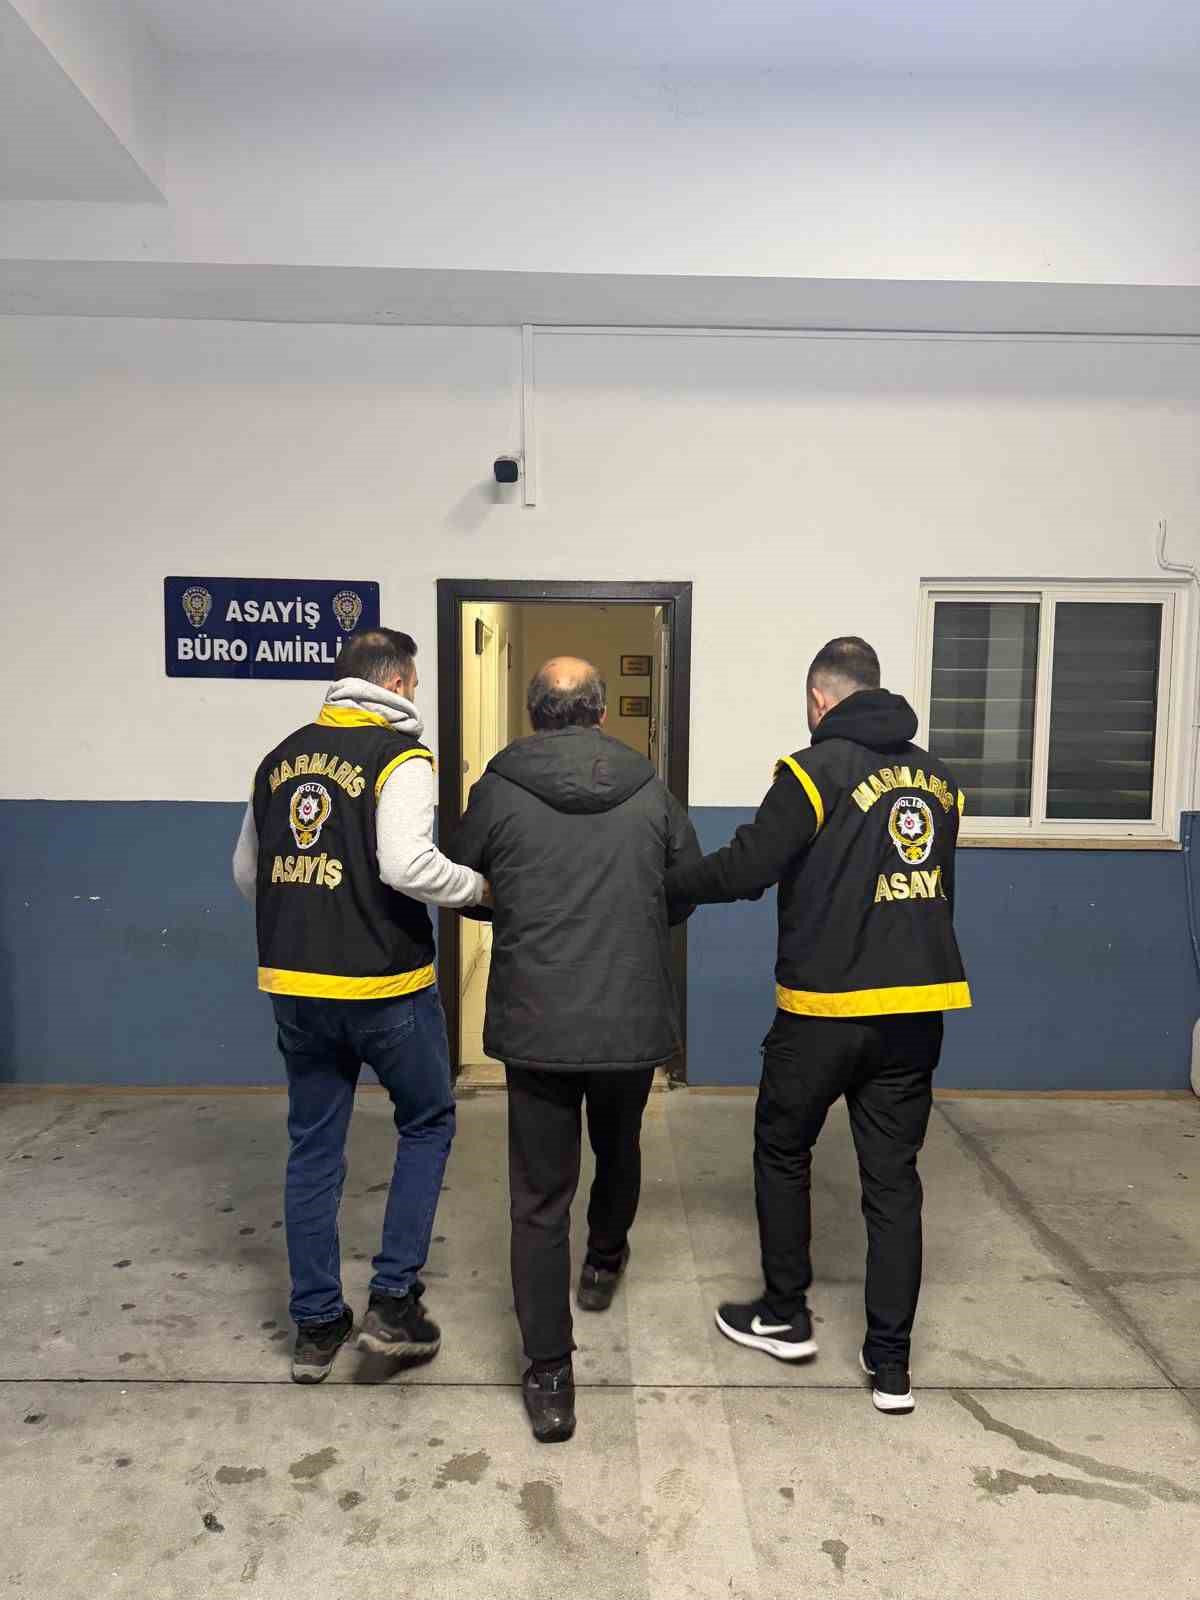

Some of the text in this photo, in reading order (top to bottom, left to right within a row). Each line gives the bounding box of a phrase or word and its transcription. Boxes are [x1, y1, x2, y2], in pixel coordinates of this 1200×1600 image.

[226, 597, 320, 629] ASAYİŞ
[177, 634, 343, 663] BÜRO AMİRLİ
[269, 753, 366, 798] MARMARİS
[851, 766, 953, 813] MARMARİS
[271, 853, 343, 890] ASAYİŞ
